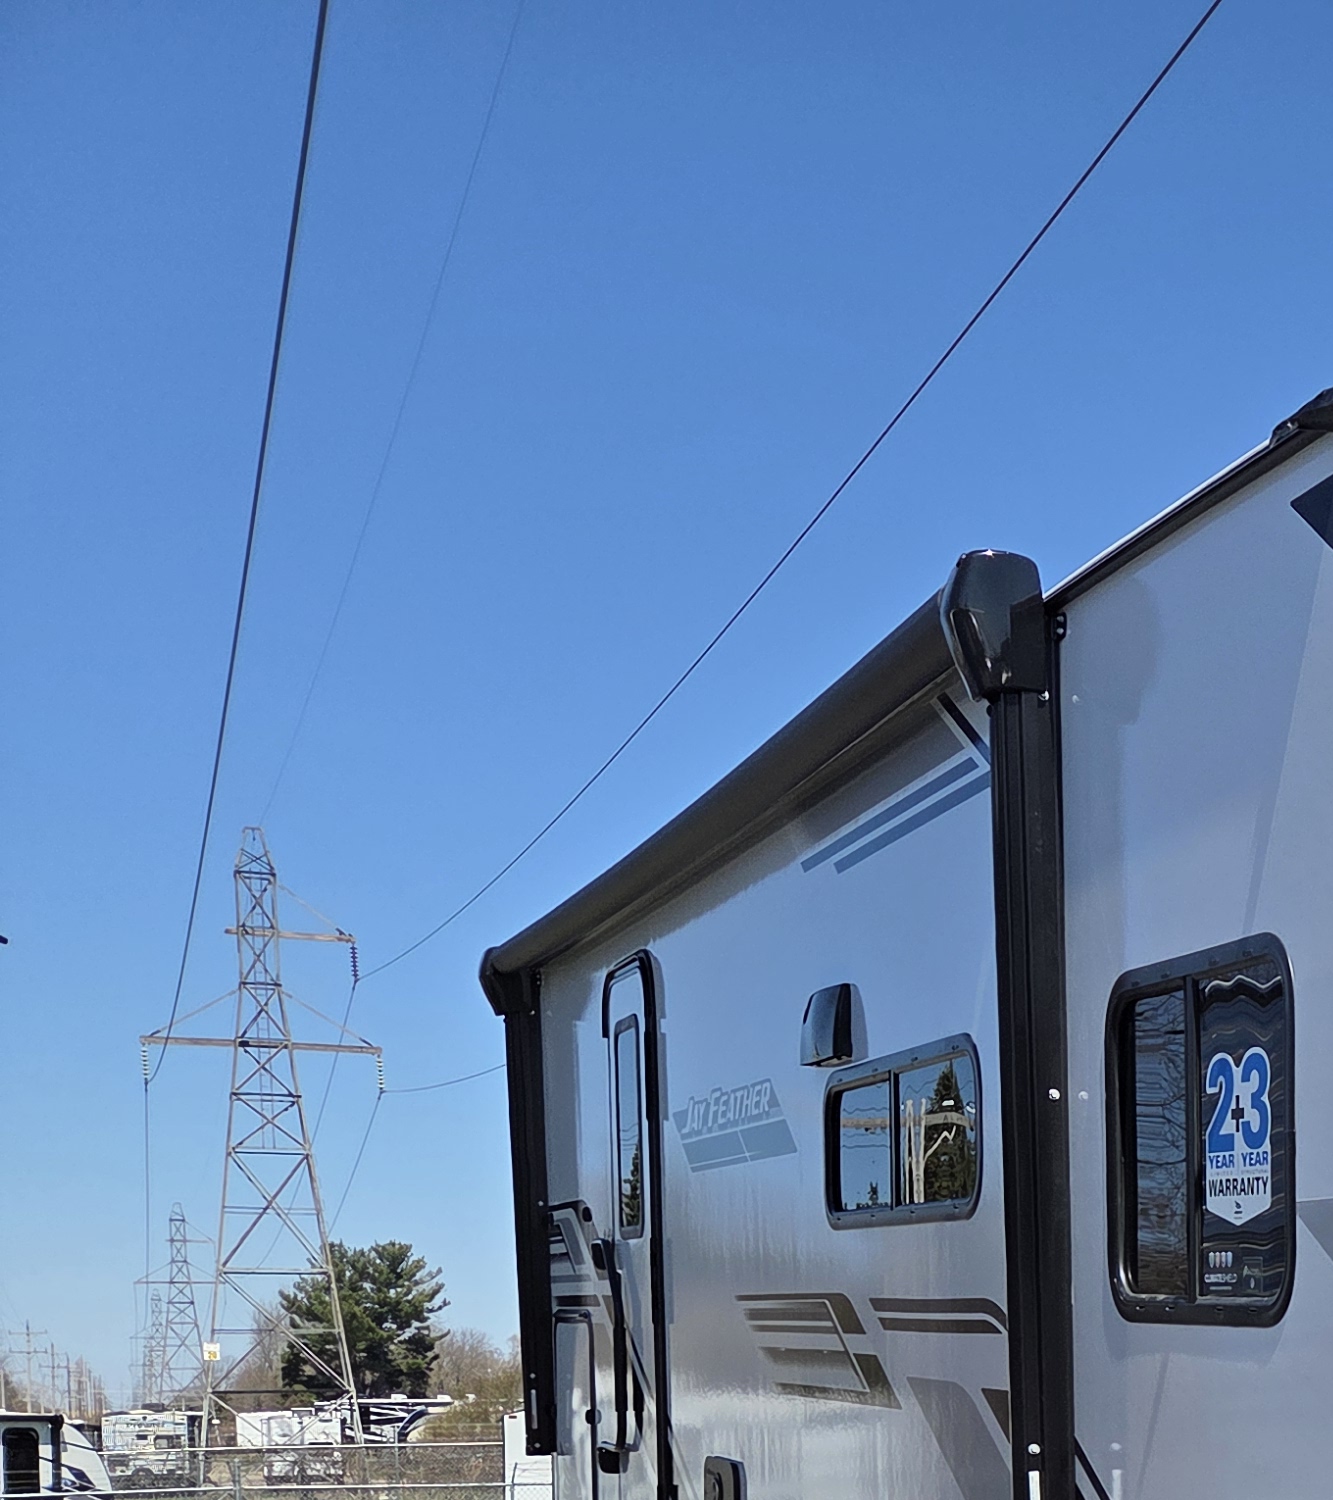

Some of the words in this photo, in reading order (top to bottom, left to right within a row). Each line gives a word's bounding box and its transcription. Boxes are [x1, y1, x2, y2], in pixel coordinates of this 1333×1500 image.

[681, 1099, 707, 1134] JAY
[708, 1081, 771, 1128] FEATHER
[1208, 1154, 1235, 1169] YEAR
[1241, 1151, 1268, 1167] YEAR
[1208, 1176, 1269, 1197] WARRANTY
